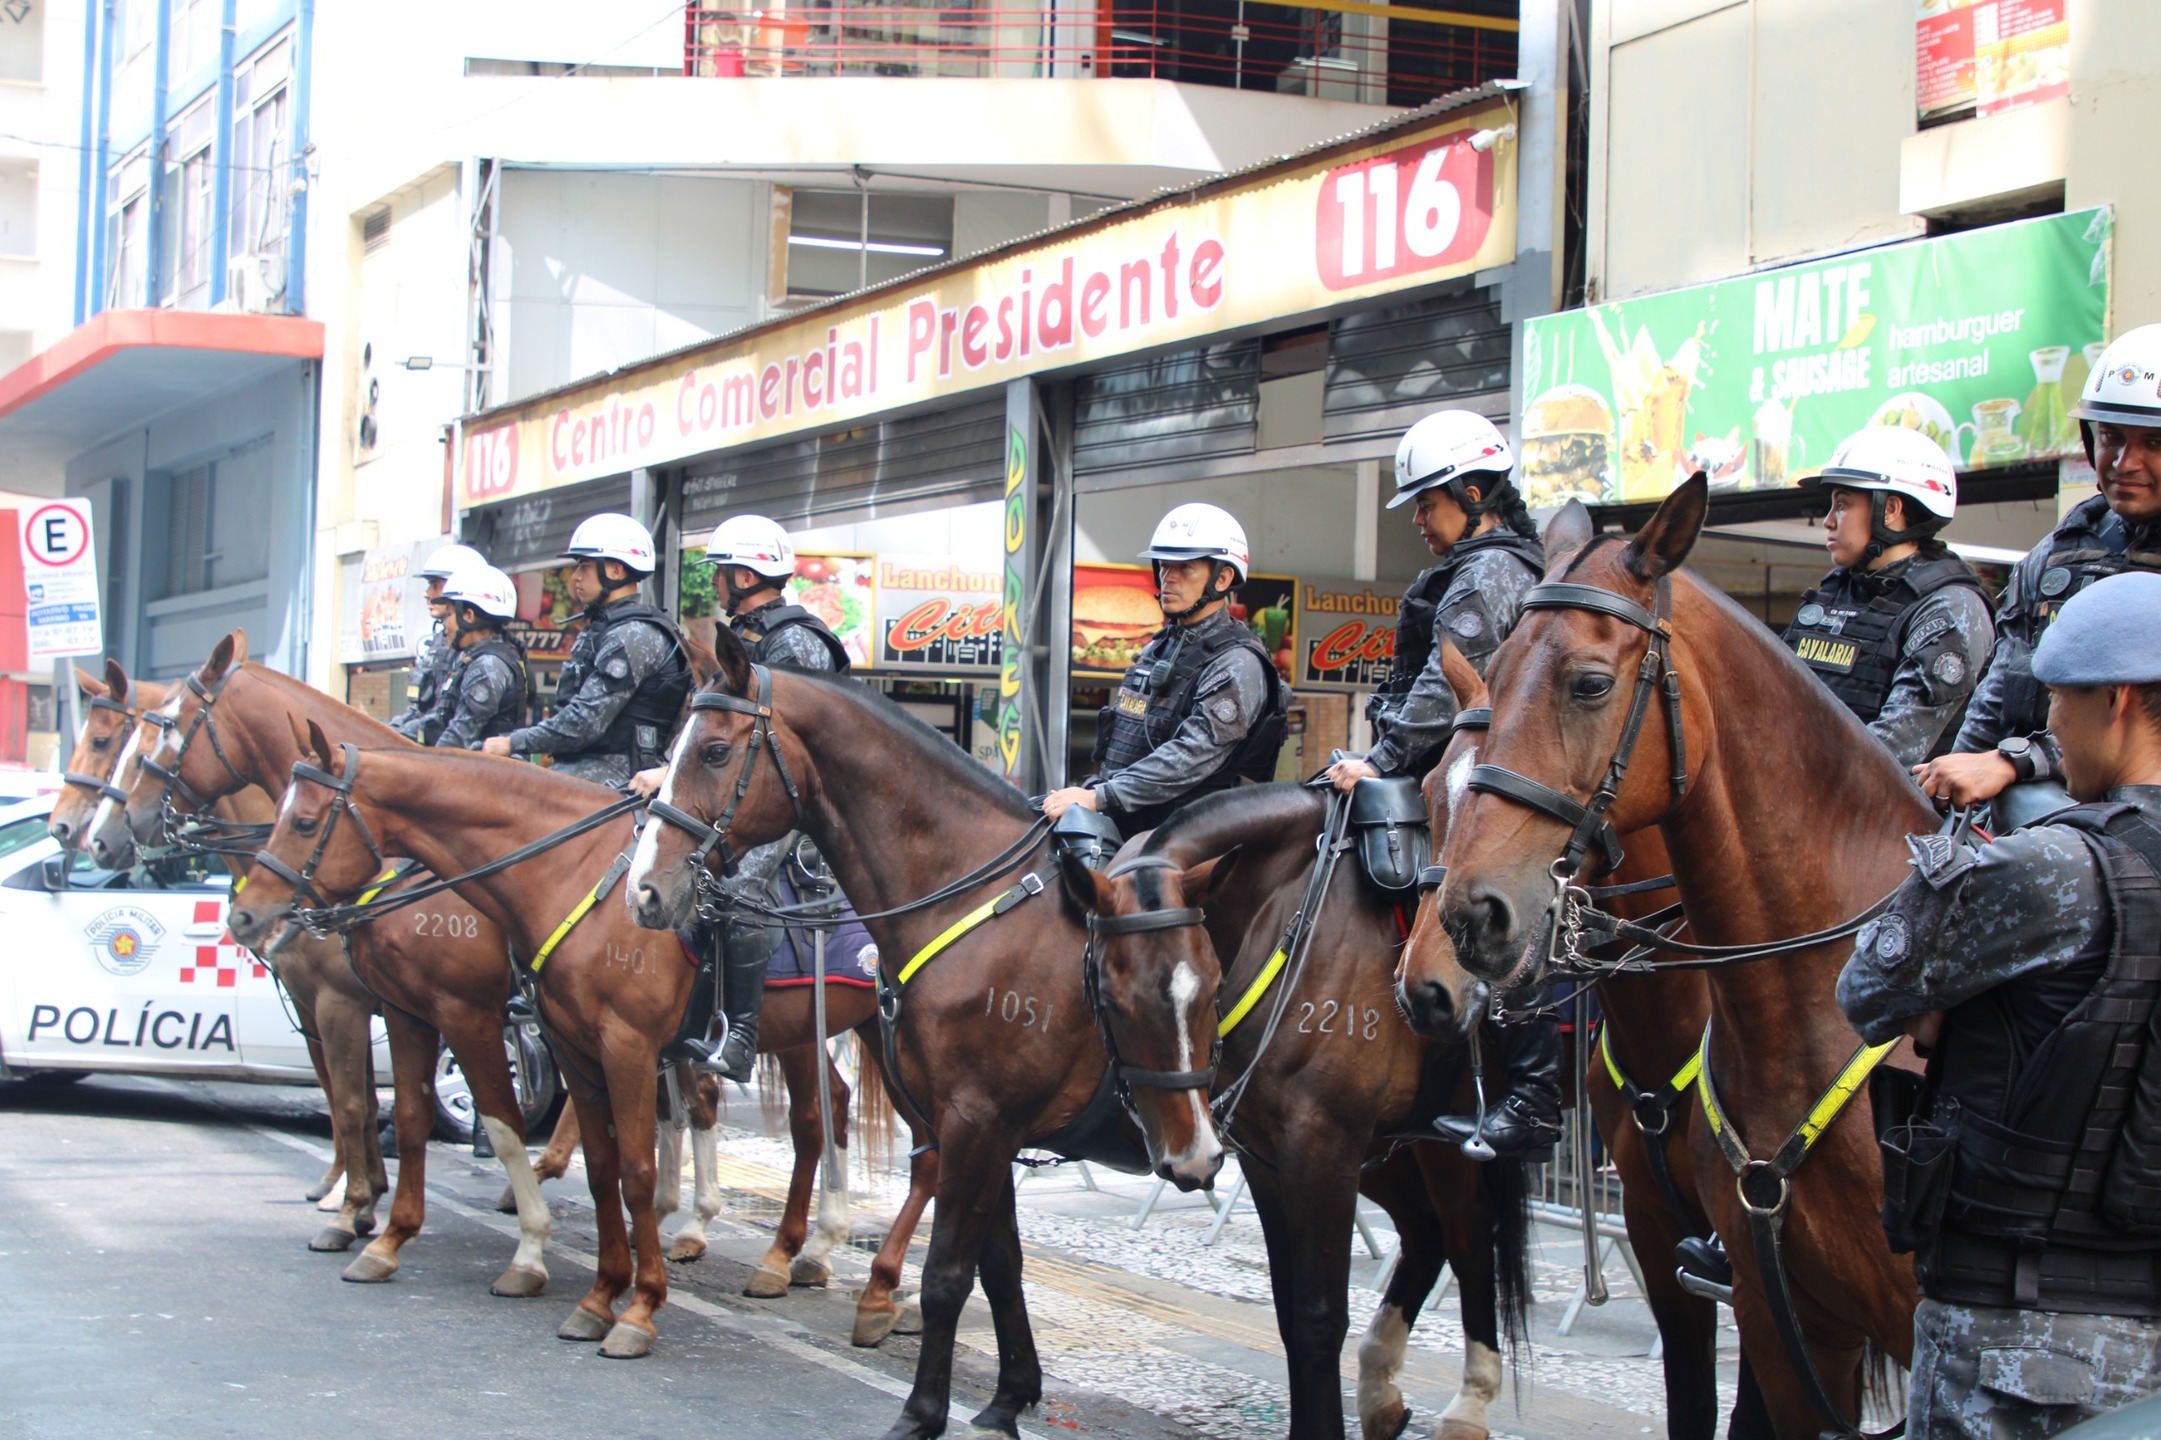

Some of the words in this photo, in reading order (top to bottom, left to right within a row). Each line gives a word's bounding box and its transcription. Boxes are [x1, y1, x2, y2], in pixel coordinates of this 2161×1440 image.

[1335, 150, 1462, 278] 116
[1753, 261, 1872, 354] MATE
[1889, 308, 2025, 351] hamburguer
[471, 426, 511, 493] 116
[552, 400, 656, 472] Centro
[677, 316, 881, 439] Comercial
[907, 230, 1225, 384] Presidente
[1749, 366, 1766, 403] &
[1771, 346, 1872, 400] SAUSAGE
[1887, 348, 1990, 389] artesanal
[2143, 372, 2155, 381] M
[45, 518, 67, 552] E
[881, 562, 1003, 593] Lanchon
[887, 596, 1003, 651] Cit
[1906, 617, 1949, 651] CHOQUE
[1796, 636, 1857, 667] CAVALARIA
[89, 908, 125, 935] POLÍCIA
[129, 909, 162, 936] MILITAR
[414, 912, 479, 938] 2208
[28, 1000, 236, 1052] POLÍCIA
[985, 986, 1053, 1033] 1051
[1298, 999, 1380, 1040] 2218
